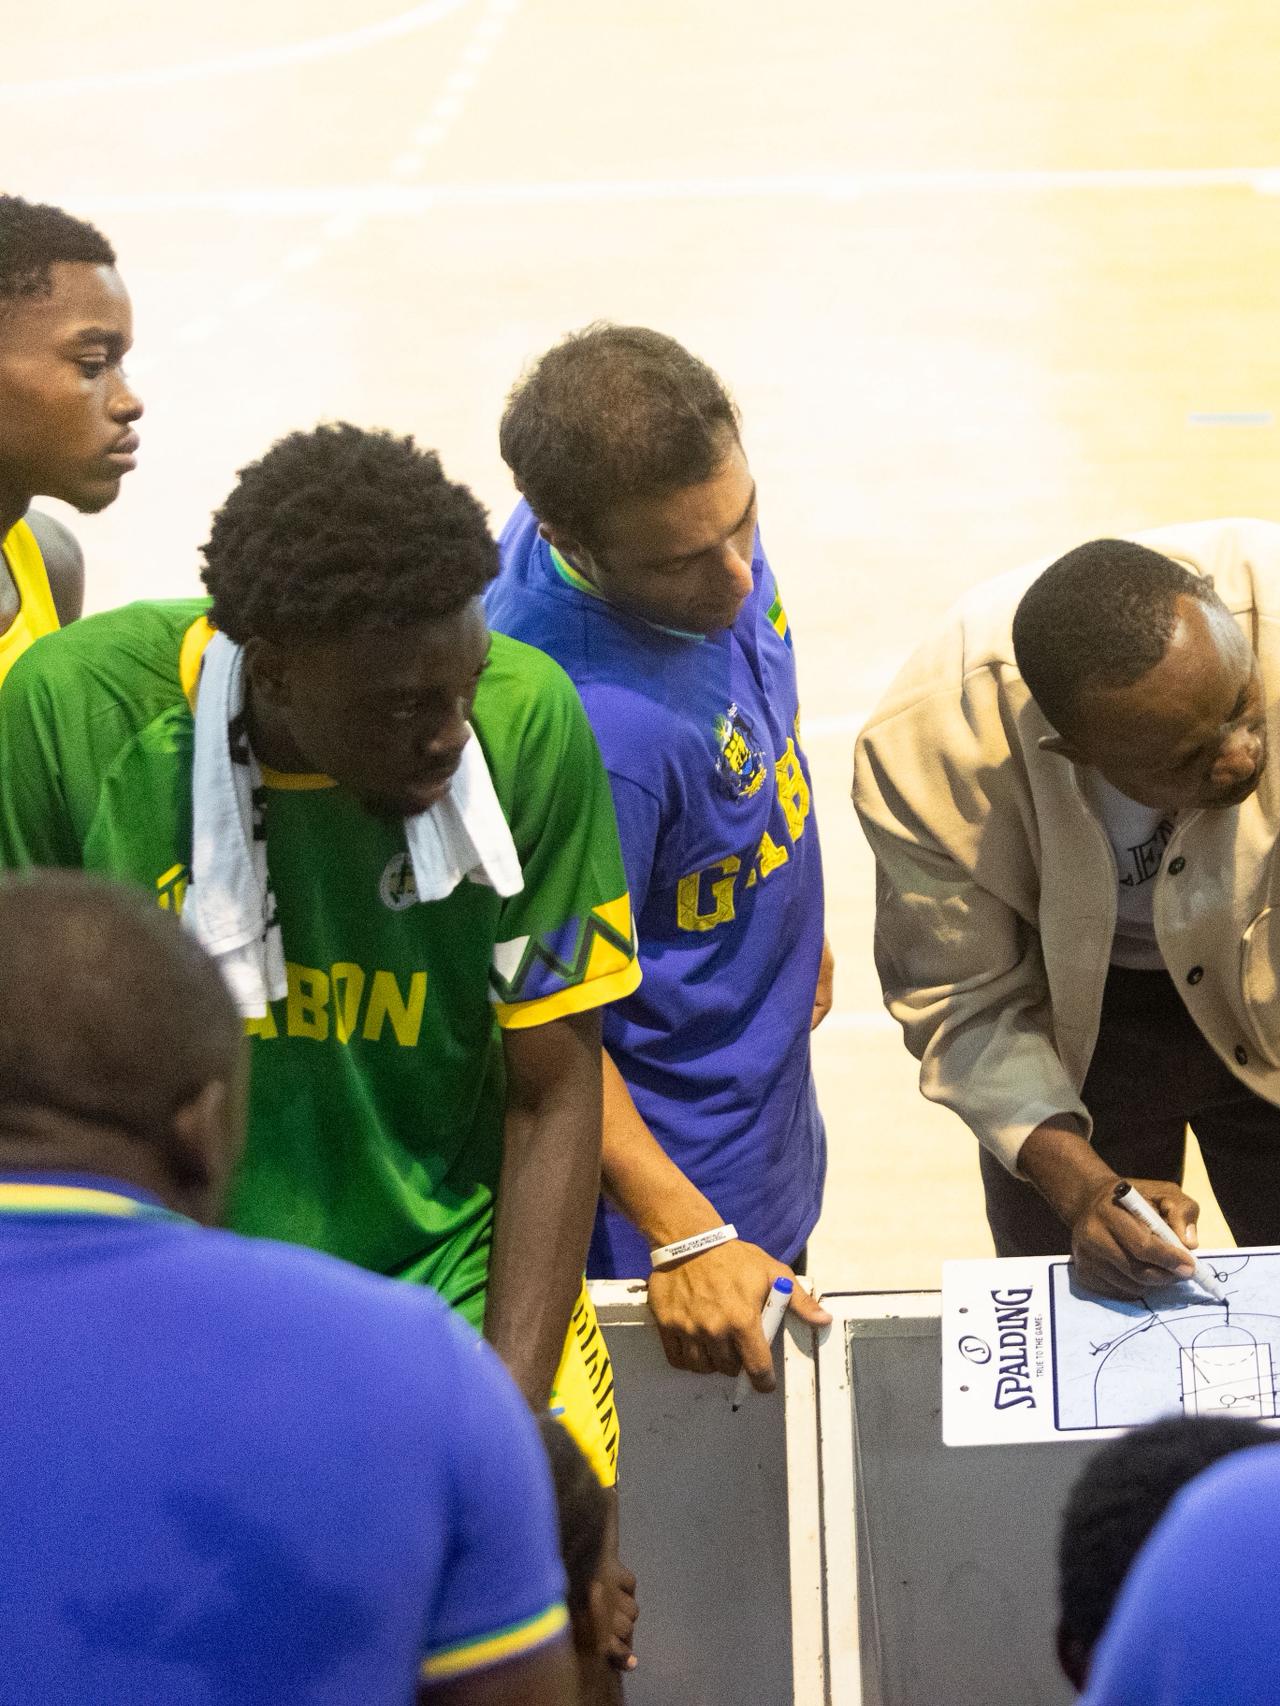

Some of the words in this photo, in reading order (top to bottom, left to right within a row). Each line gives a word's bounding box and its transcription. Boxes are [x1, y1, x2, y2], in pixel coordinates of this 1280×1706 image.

[677, 733, 811, 932] GAB
[990, 1288, 1036, 1410] SPALDING
[1035, 1337, 1044, 1350] THE
[1036, 1350, 1044, 1360] TO
[1036, 1360, 1044, 1378] TRUE
